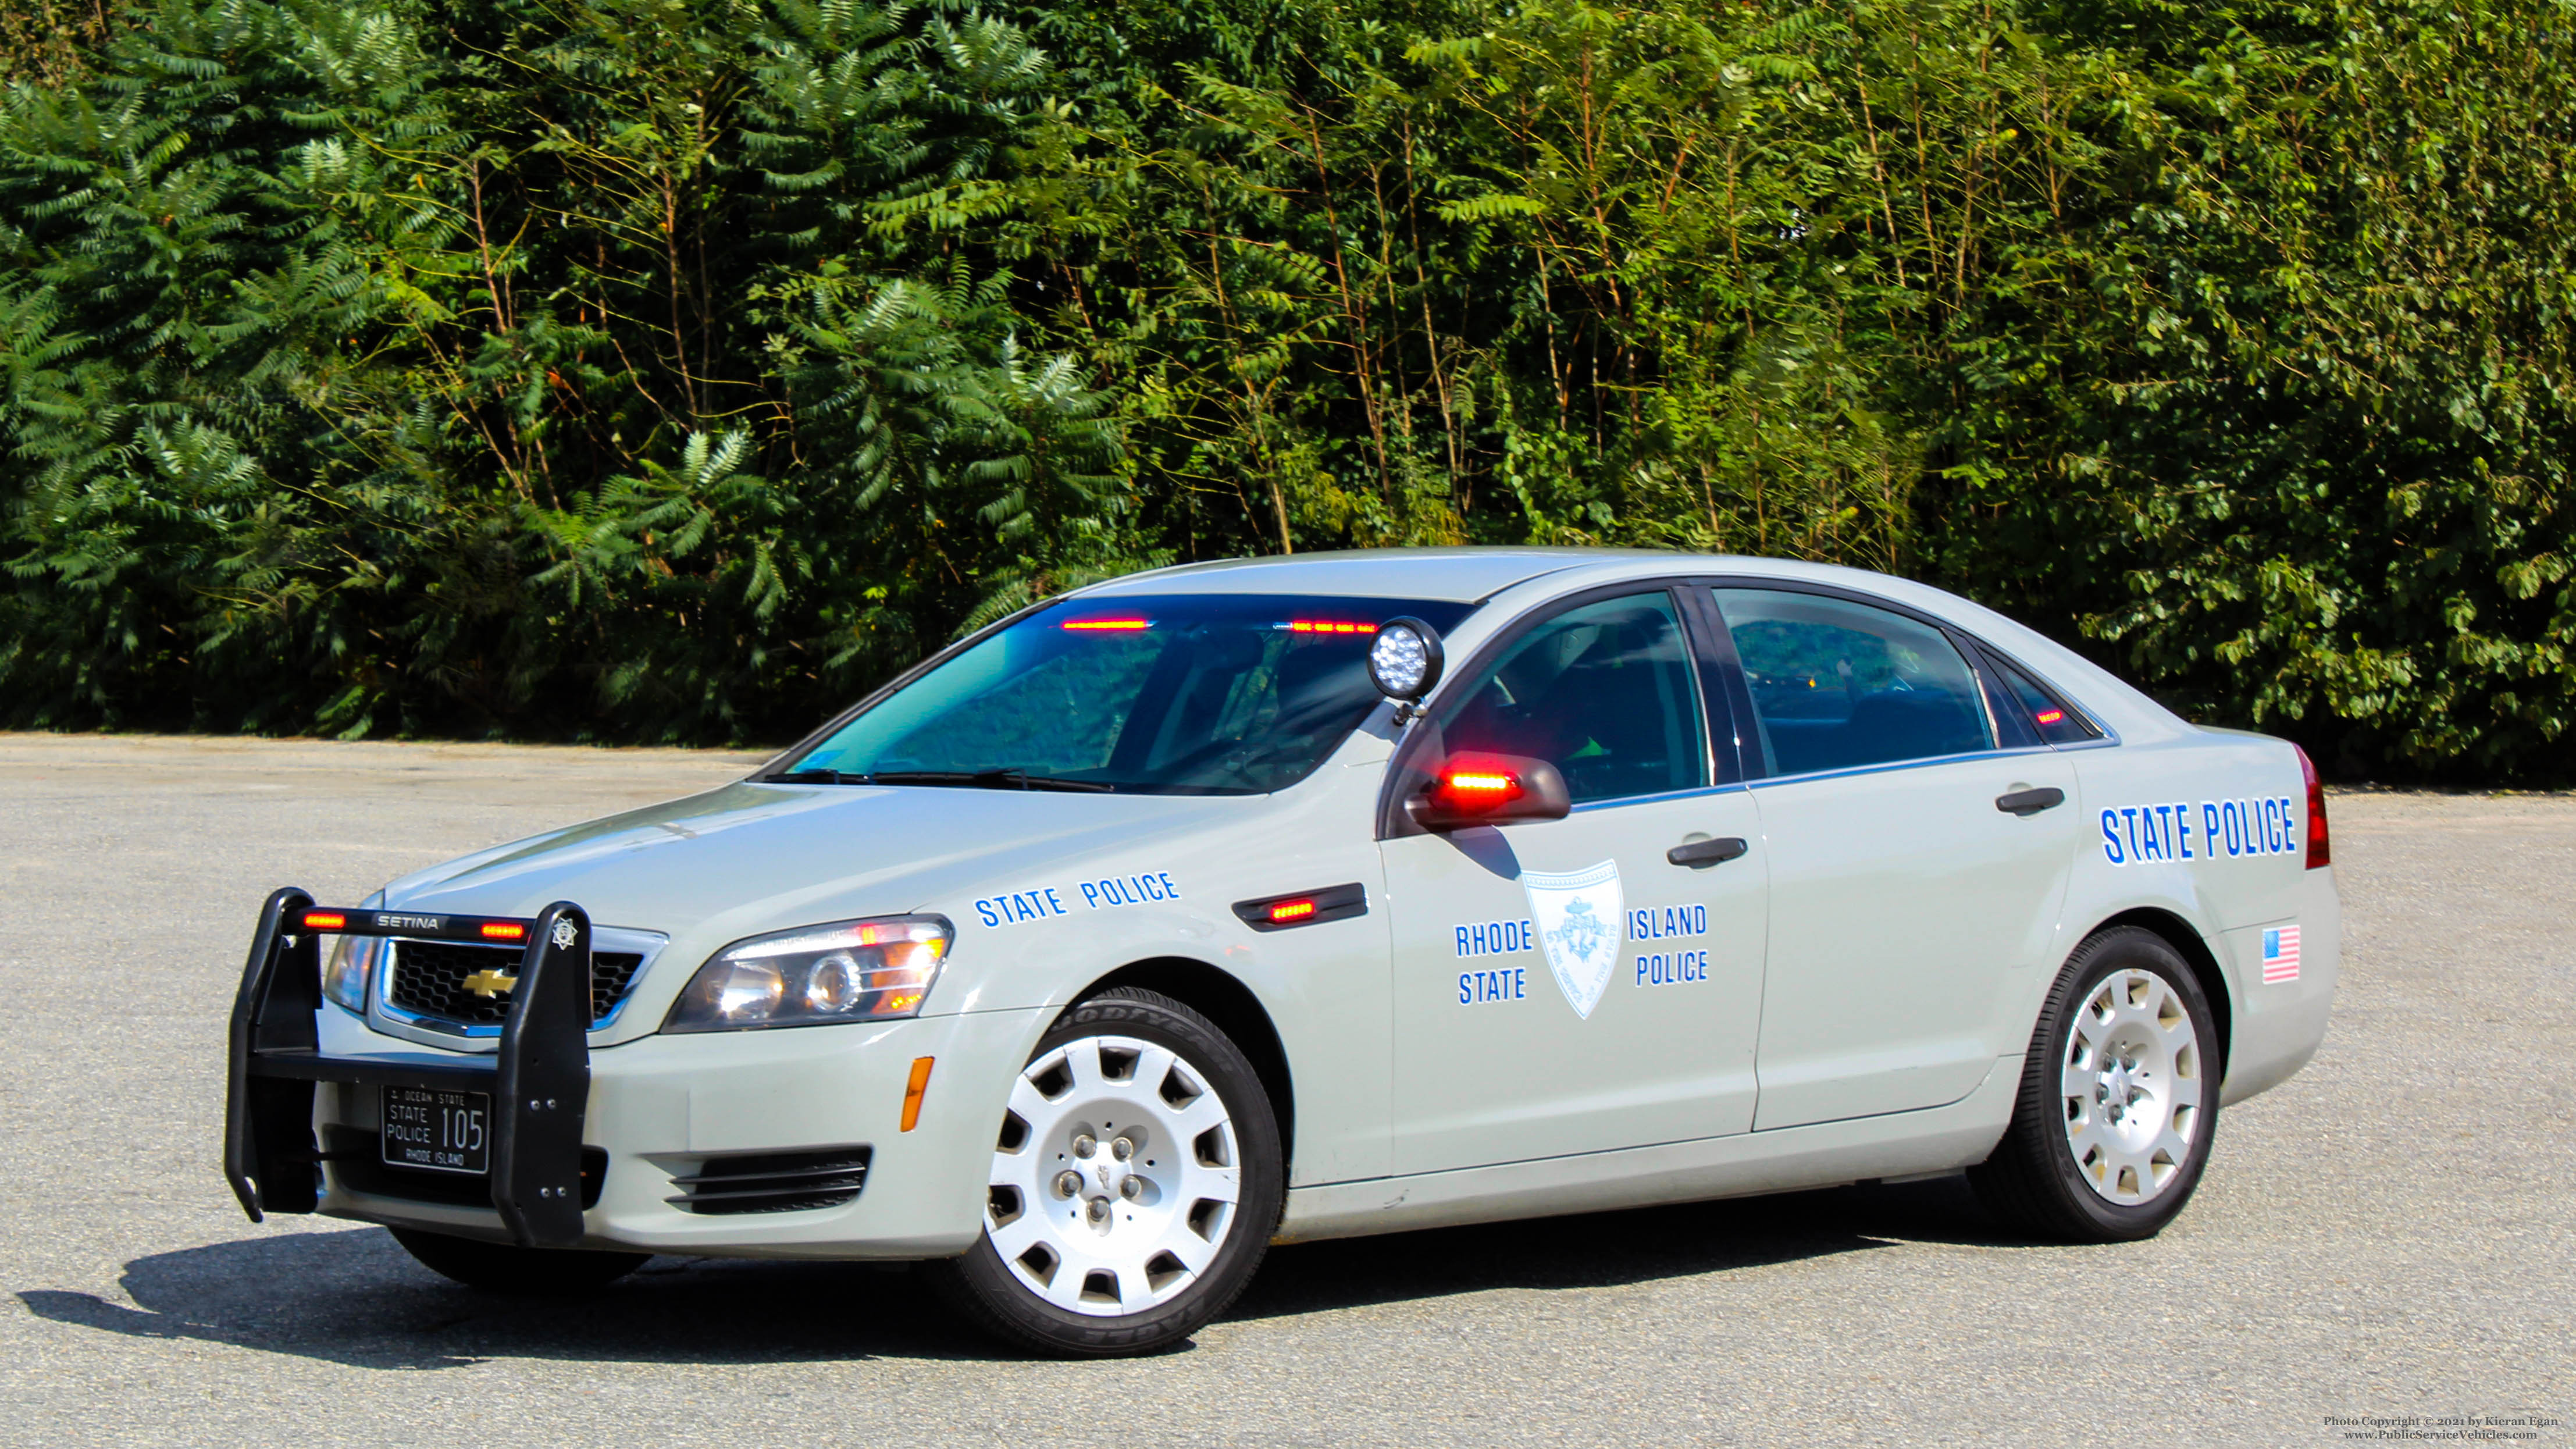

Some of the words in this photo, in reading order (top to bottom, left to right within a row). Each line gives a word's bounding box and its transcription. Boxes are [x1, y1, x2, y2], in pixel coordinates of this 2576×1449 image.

[2100, 803, 2194, 865] STATE
[2201, 798, 2297, 858] POLICE
[975, 888, 1068, 928] STATE
[1079, 872, 1180, 909] POLICE
[377, 915, 439, 930] SETINA
[1455, 920, 1533, 957] RHODE
[1629, 904, 1707, 940] ISLAND
[1459, 968, 1526, 1005] STATE
[1637, 950, 1708, 987] POLICE
[390, 1105, 427, 1123] STATE
[405, 1091, 433, 1102] OCEAN
[439, 1094, 465, 1106] STATE
[387, 1123, 431, 1144] POLICE
[443, 1108, 483, 1150] 105
[406, 1148, 432, 1163] RHODE
[435, 1152, 464, 1166] ISLAND
